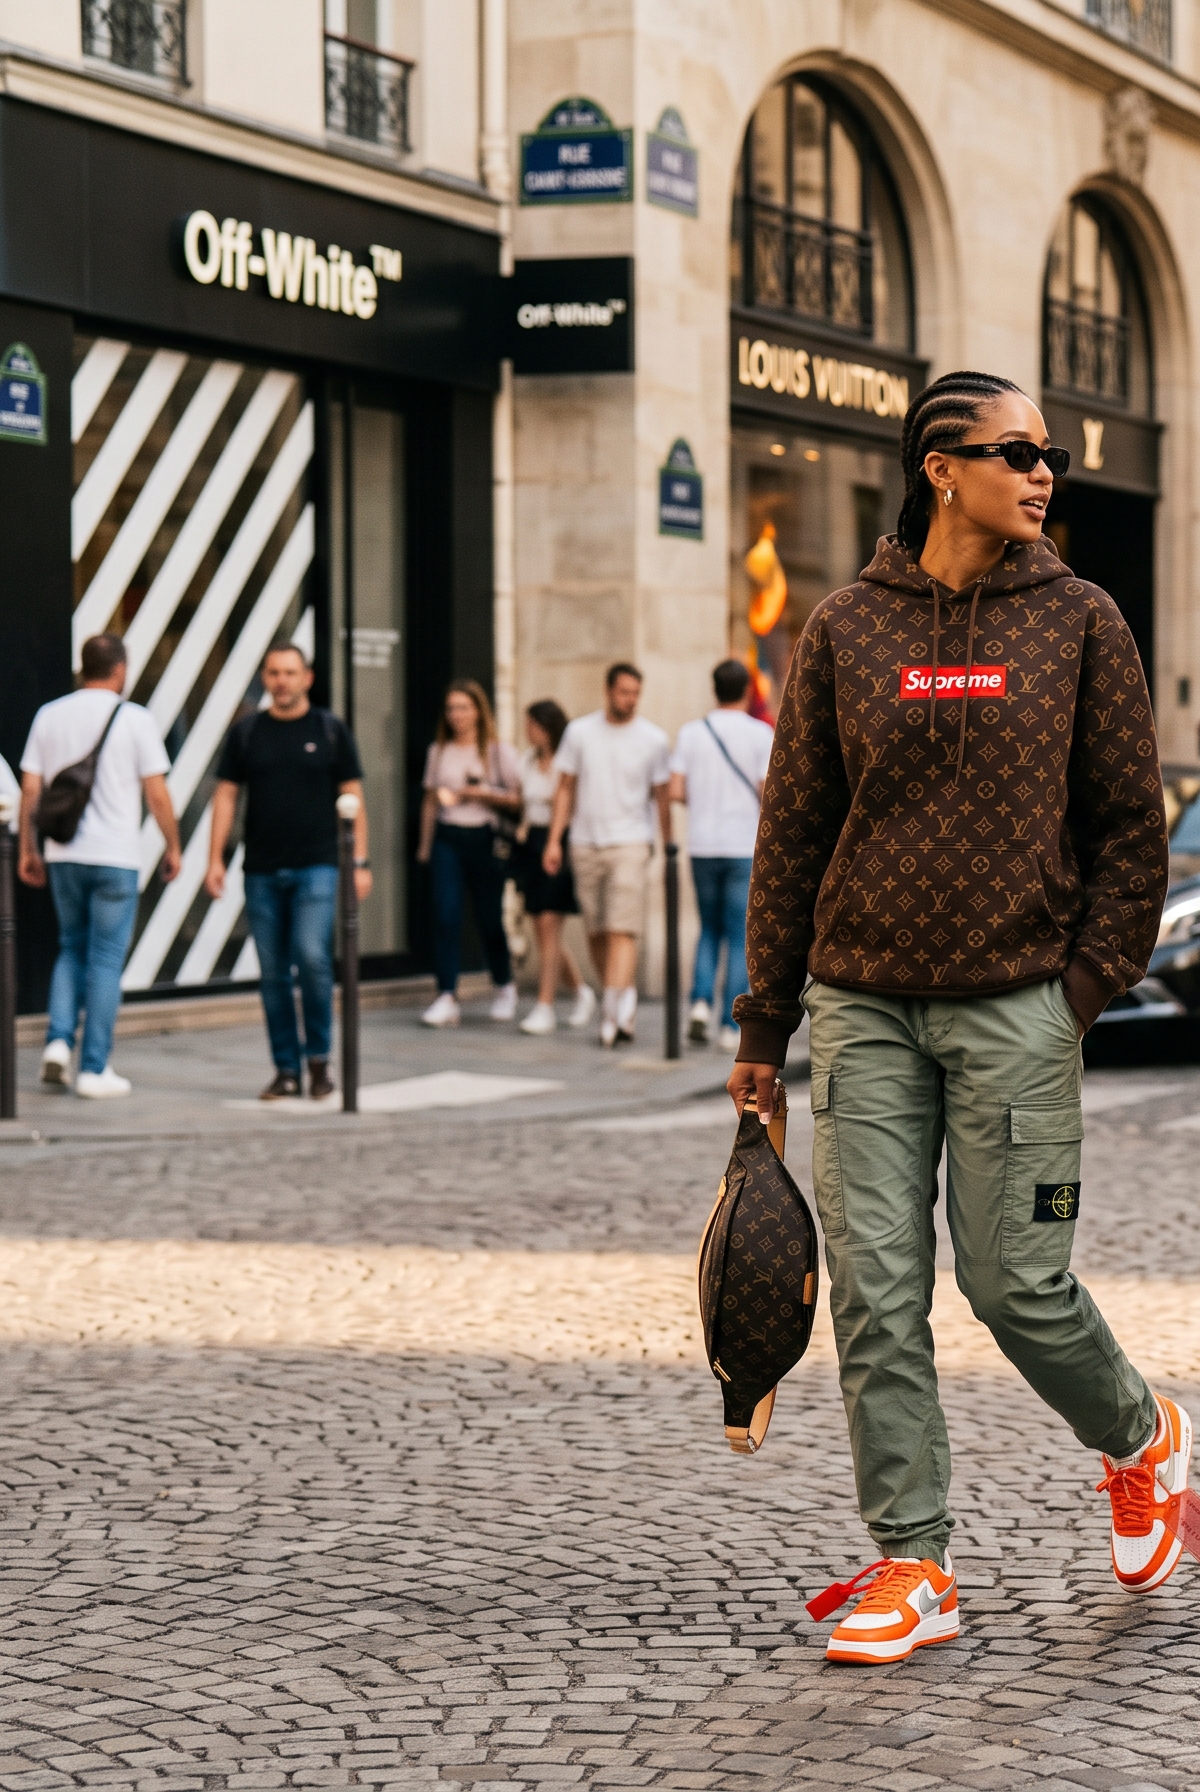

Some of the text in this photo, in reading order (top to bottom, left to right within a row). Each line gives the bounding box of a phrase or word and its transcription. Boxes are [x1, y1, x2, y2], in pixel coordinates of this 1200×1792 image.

[738, 336, 910, 421] LOUIS VUITTON
[905, 670, 1002, 698] Supreme
